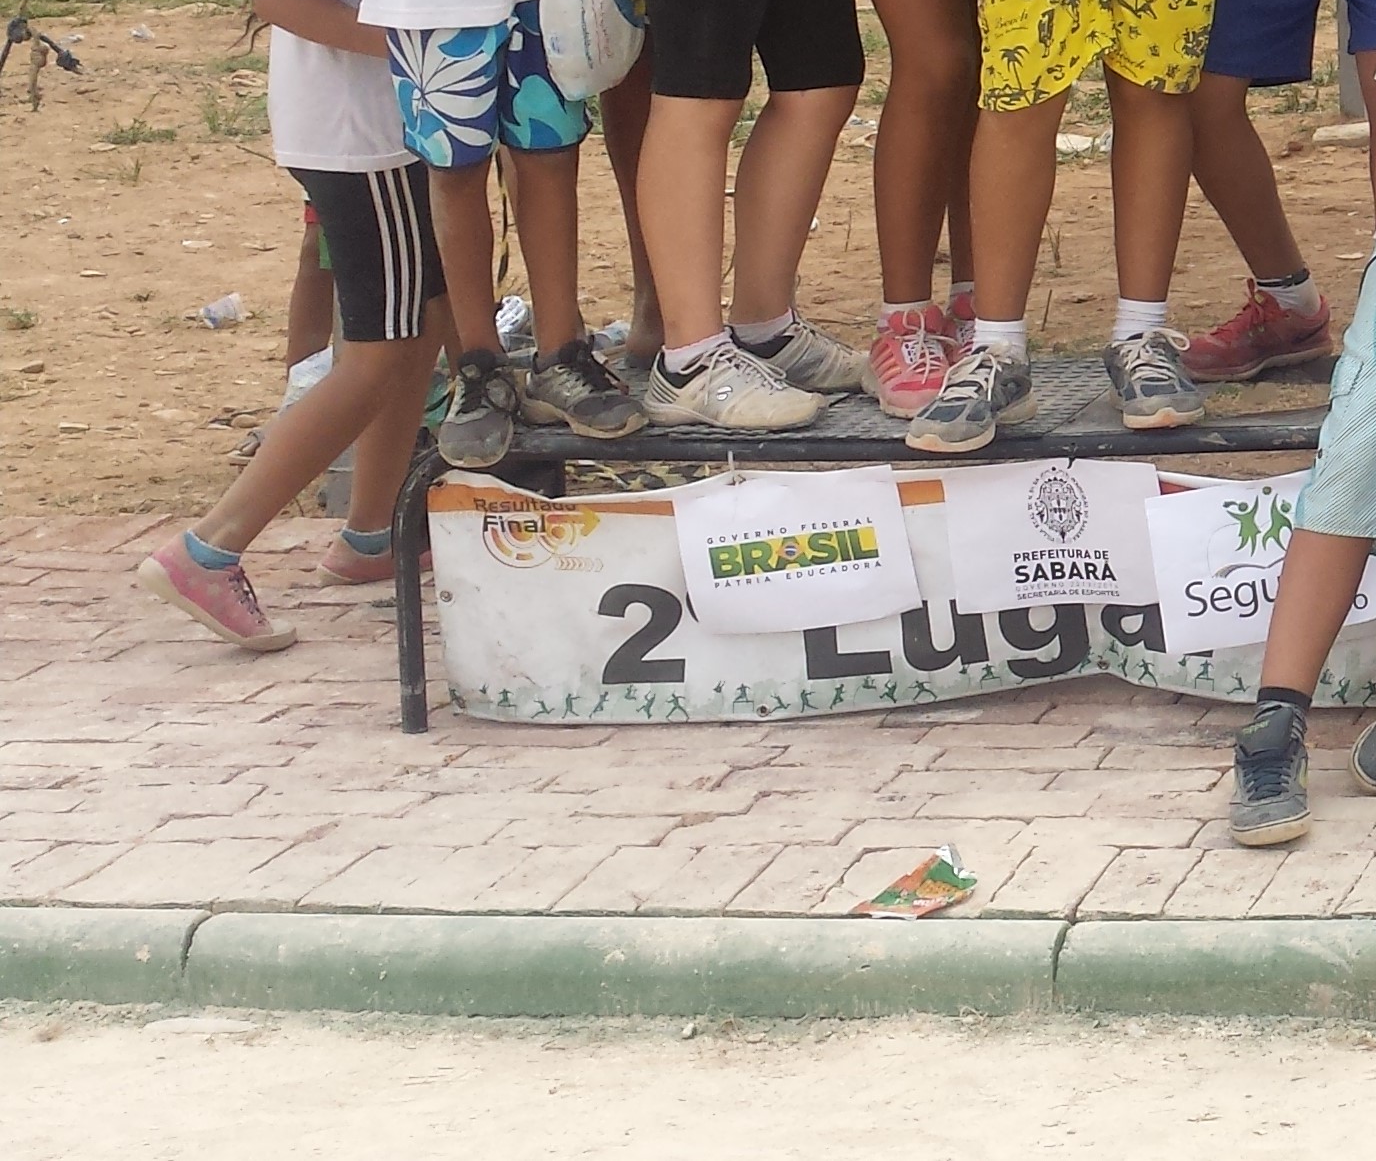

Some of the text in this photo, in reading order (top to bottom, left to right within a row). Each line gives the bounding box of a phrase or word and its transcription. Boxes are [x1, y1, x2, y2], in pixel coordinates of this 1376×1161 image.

[473, 497, 577, 514] Resultado
[482, 514, 547, 533] Final
[707, 517, 873, 545] GOVERNO FEDERAL
[708, 527, 880, 579] BRASIL
[1014, 548, 1110, 562] PREFEITURA DE
[714, 560, 882, 589] PÁTRIA EDUCADORA
[1014, 560, 1117, 584] SABARÁ
[1185, 579, 1281, 618] Segu
[804, 596, 1170, 682] Luga
